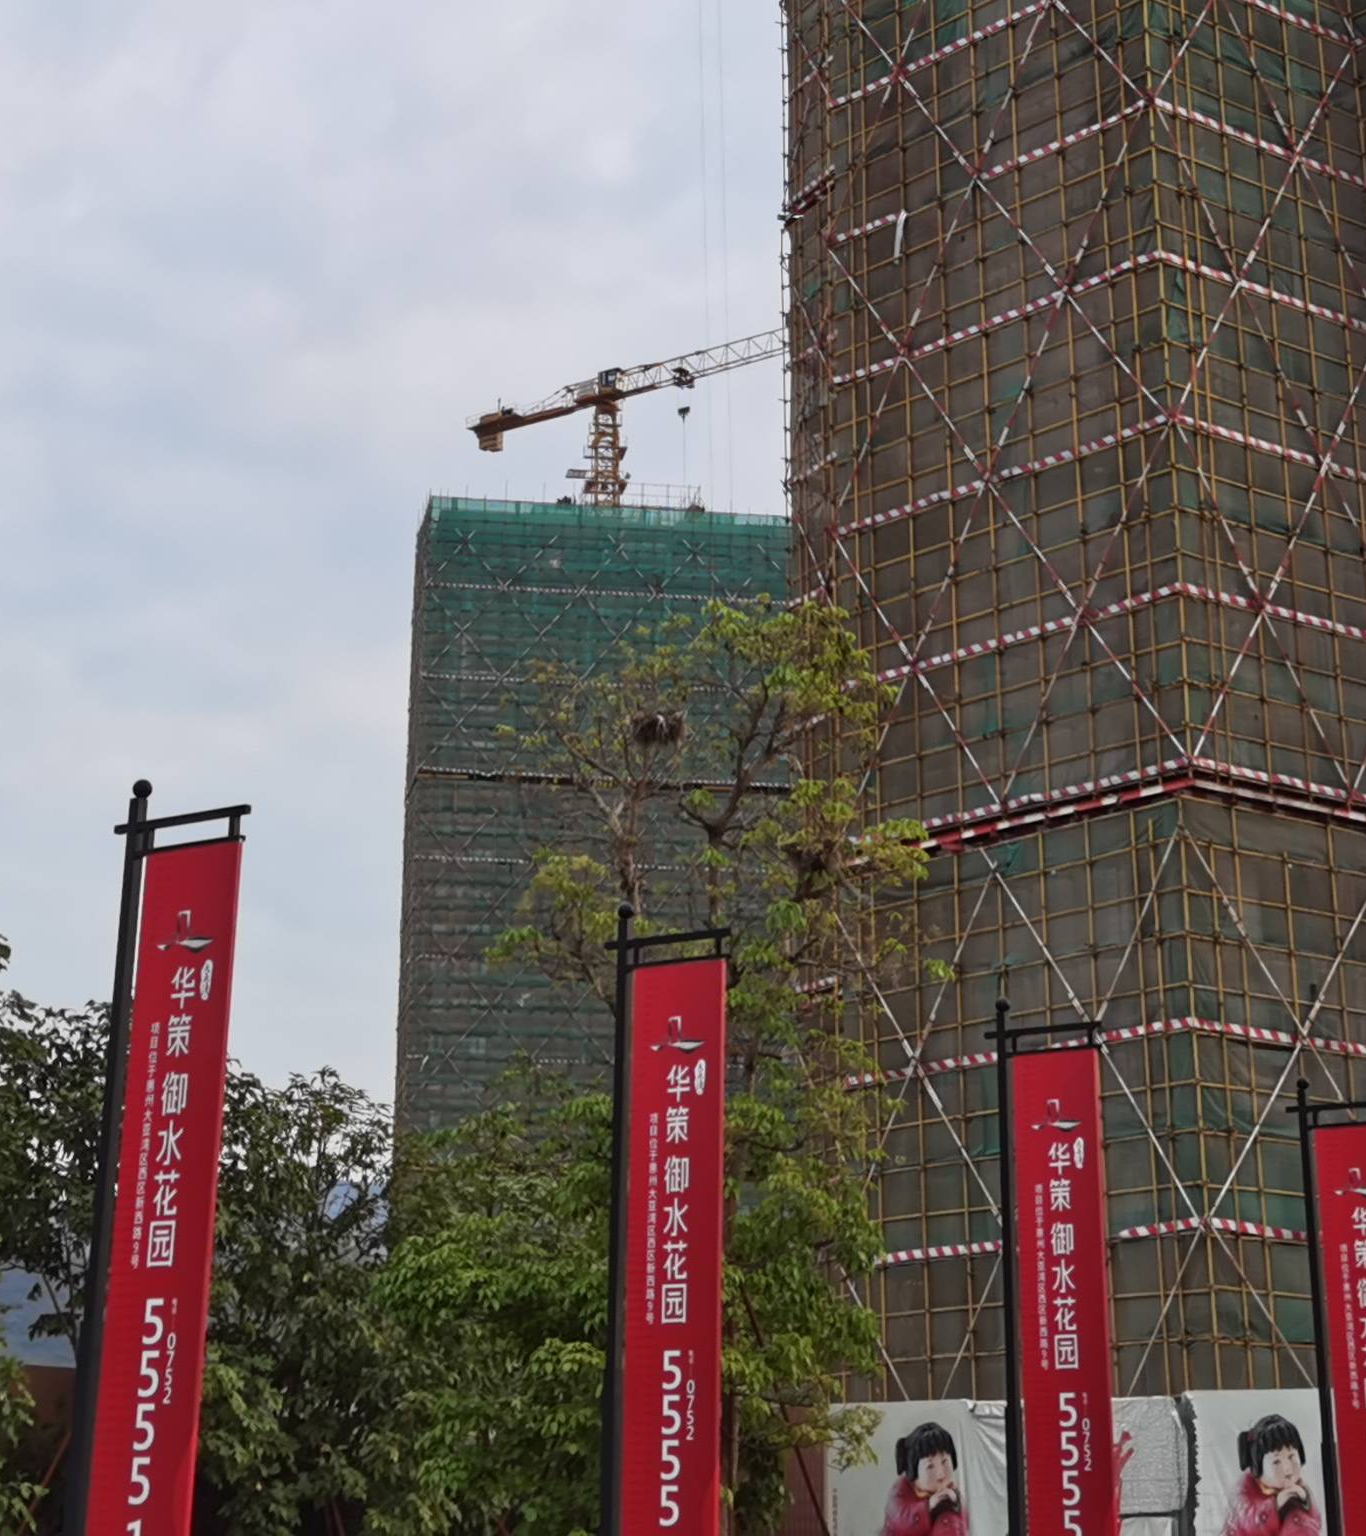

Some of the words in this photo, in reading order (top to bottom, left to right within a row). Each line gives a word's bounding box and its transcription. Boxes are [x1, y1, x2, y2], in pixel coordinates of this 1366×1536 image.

[162, 1332, 177, 1405] 0752
[658, 1349, 682, 1527] 5555
[685, 1379, 696, 1441] 0752
